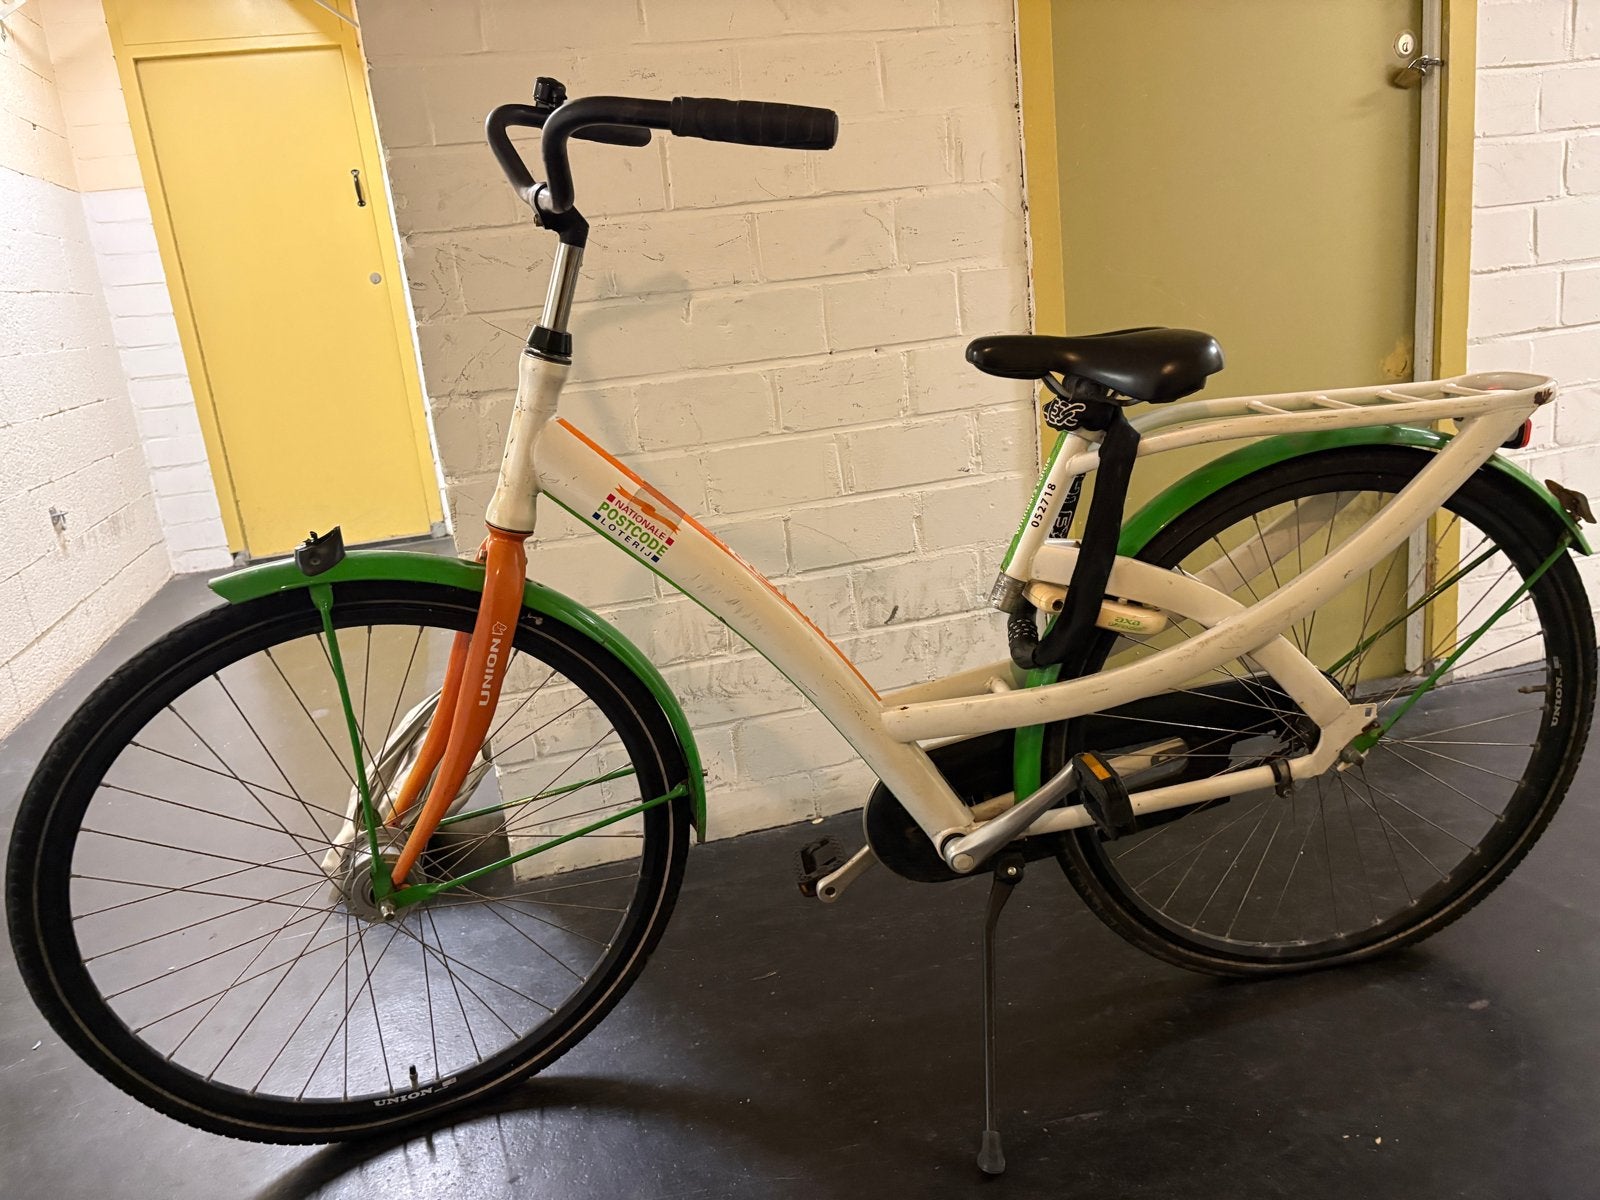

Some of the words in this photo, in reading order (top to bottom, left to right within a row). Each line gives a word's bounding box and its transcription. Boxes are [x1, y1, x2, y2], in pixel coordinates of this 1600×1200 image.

[615, 500, 667, 541] NATIONALE
[1031, 483, 1056, 528] 052718
[597, 501, 669, 557] POSTCODE
[600, 517, 652, 557] LOTERIJ
[478, 638, 502, 706] UNION
[1550, 676, 1563, 727] UNION
[373, 1086, 433, 1107] UNION
